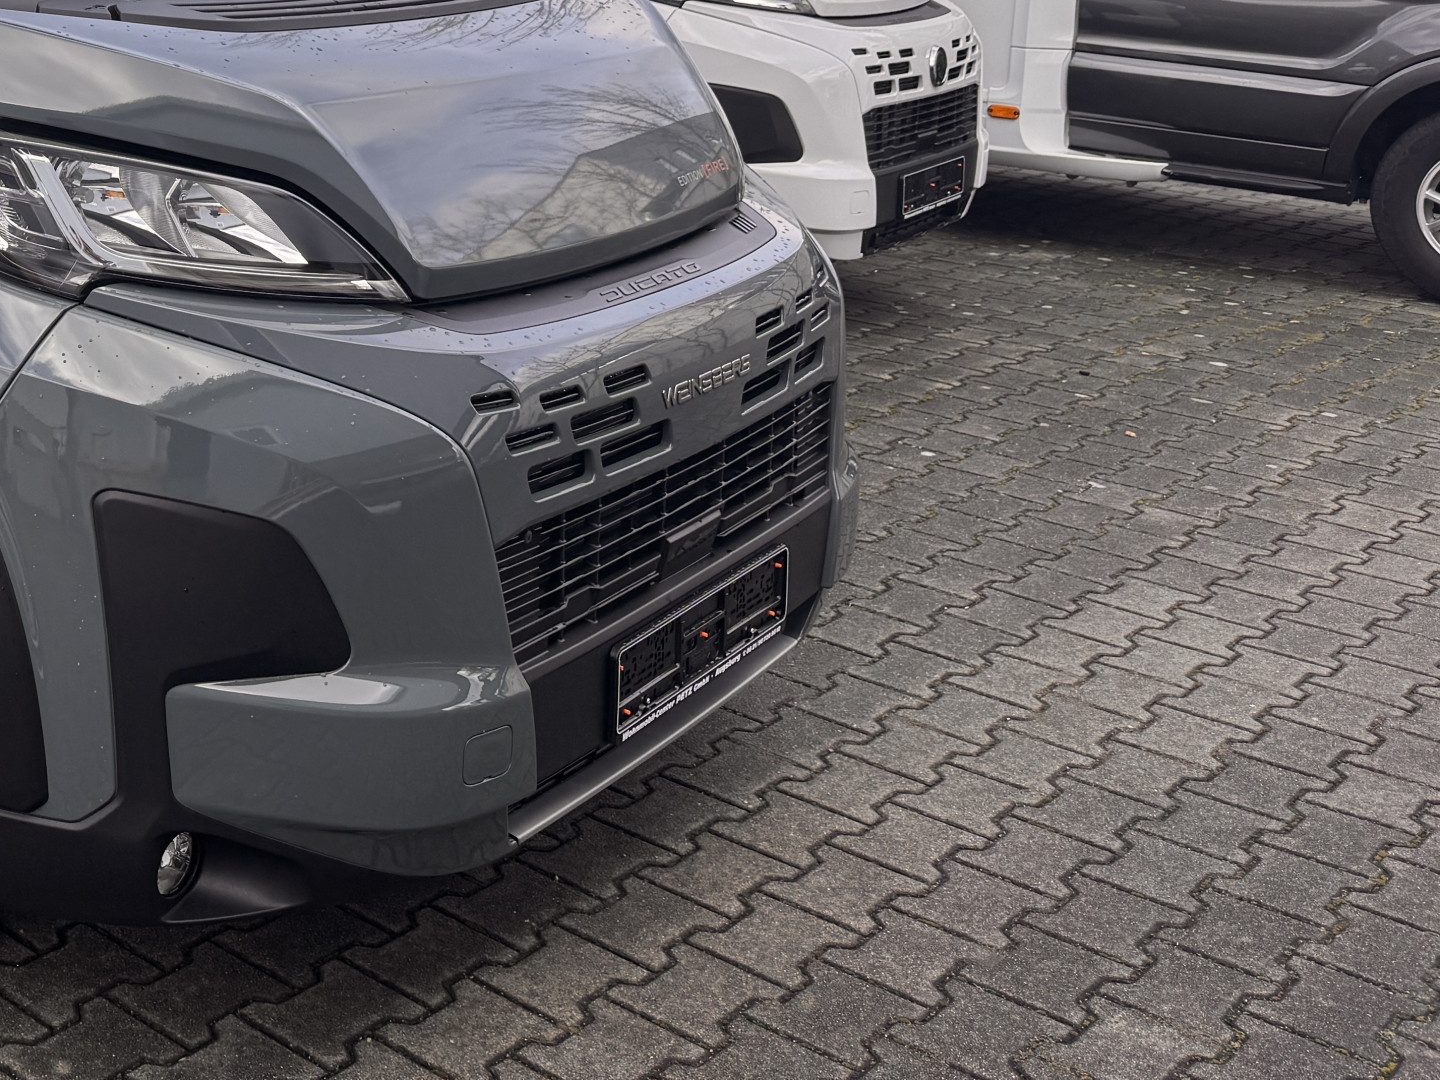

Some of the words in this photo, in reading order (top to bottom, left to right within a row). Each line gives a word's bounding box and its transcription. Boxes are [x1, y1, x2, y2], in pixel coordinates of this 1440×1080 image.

[677, 168, 705, 187] EDITION
[599, 262, 702, 303] DUCATO
[661, 353, 752, 410] WEINSBERG
